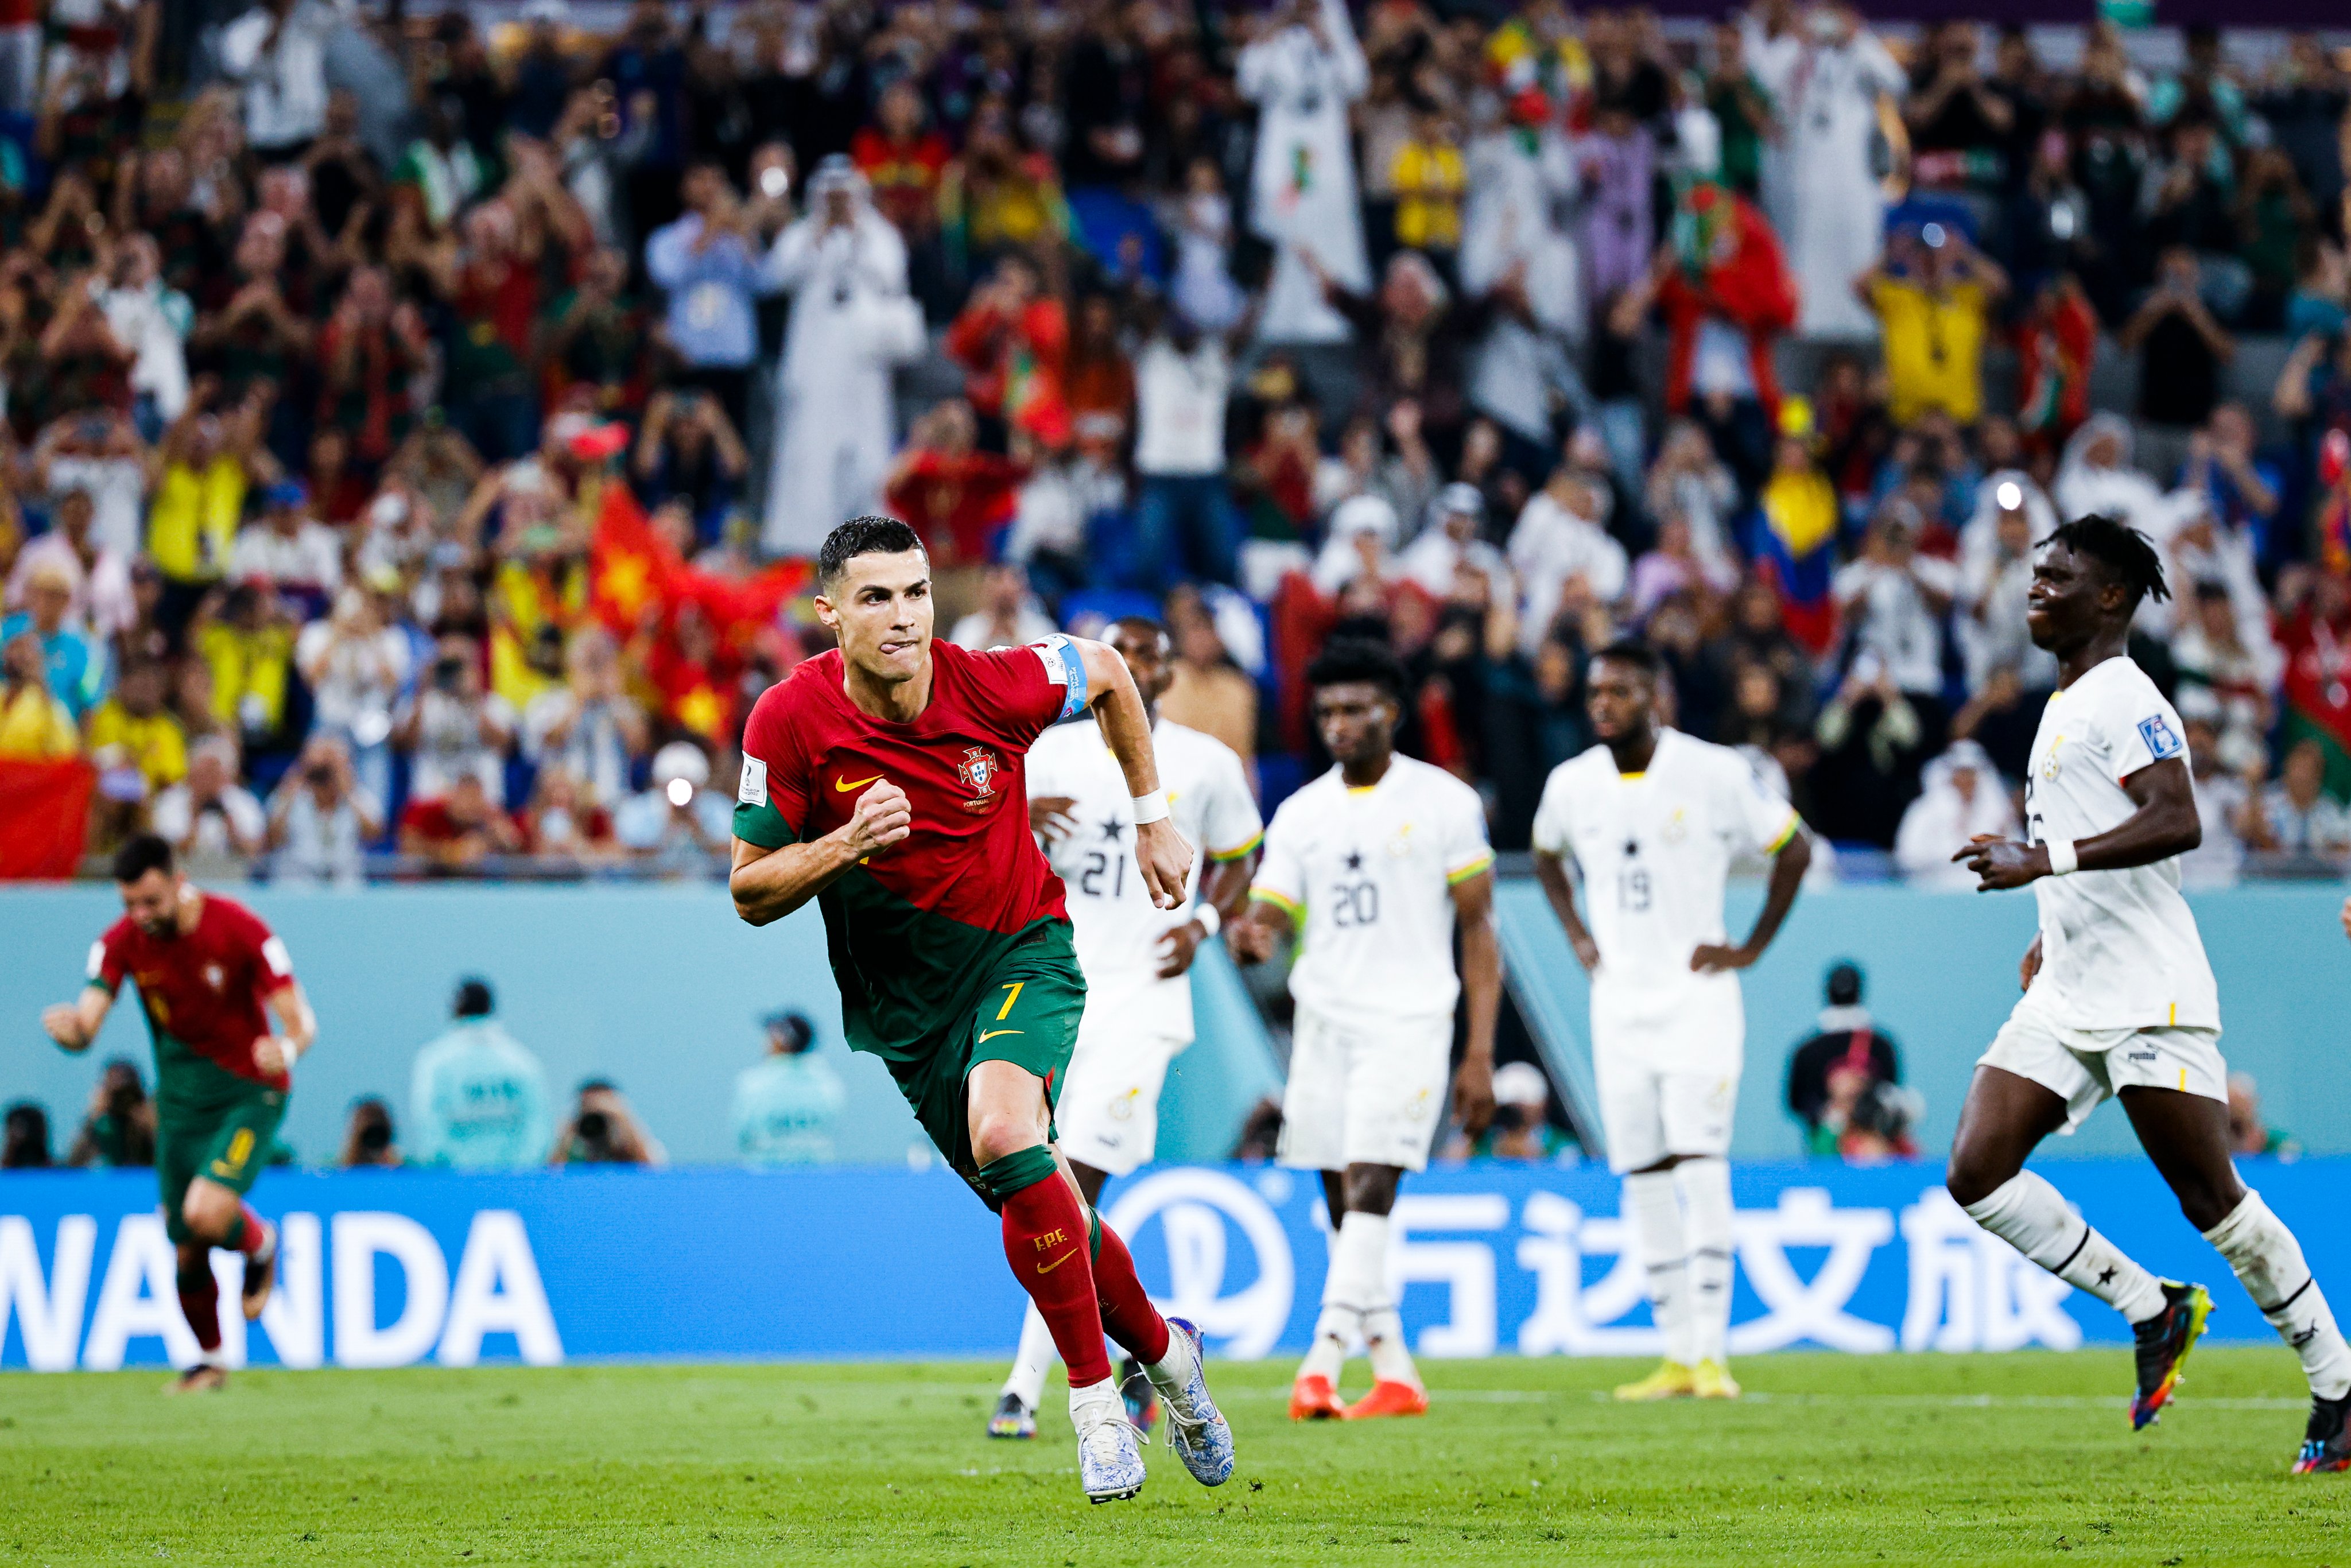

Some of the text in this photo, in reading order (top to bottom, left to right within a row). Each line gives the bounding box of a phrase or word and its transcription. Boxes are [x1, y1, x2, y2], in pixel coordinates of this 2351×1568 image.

[963, 799, 990, 808] PORTUGAL
[1081, 851, 1124, 896] 21
[1617, 869, 1652, 911] 19
[1331, 882, 1379, 927] 20
[996, 982, 1025, 1020] 7
